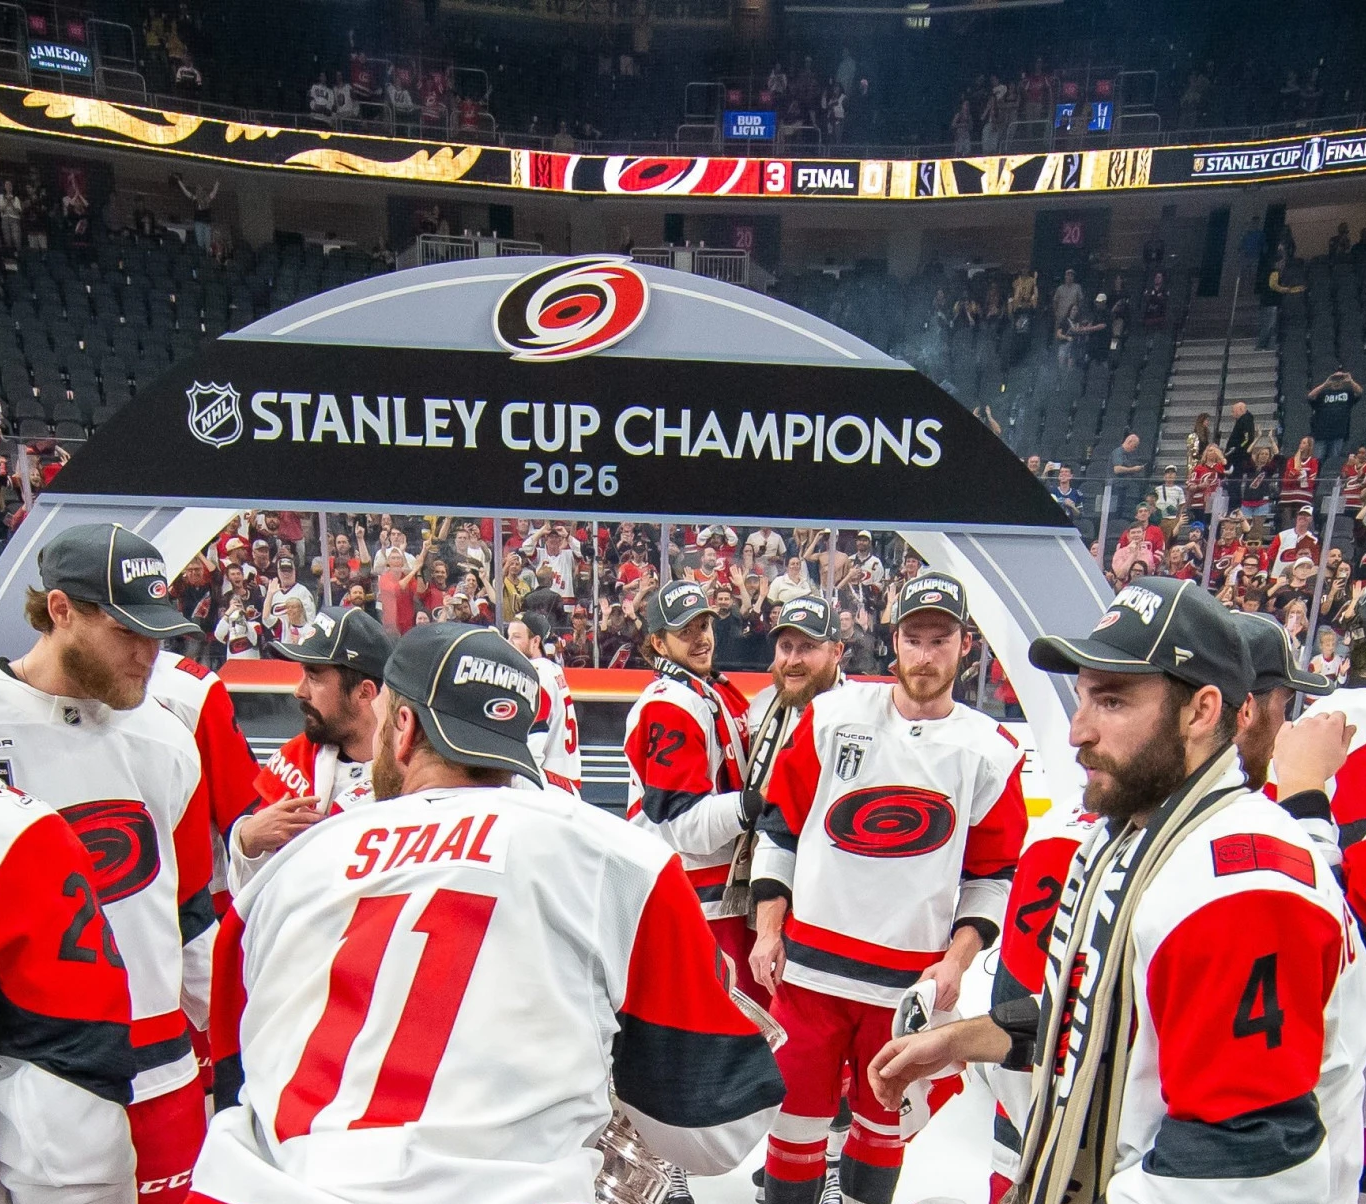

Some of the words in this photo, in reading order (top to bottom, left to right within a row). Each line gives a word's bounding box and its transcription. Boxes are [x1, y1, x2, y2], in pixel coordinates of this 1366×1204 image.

[30, 45, 88, 67] JAMESON
[732, 125, 766, 136] LIGHT
[737, 115, 762, 126] BUD
[1206, 154, 1270, 172] STANLEY
[1271, 149, 1301, 167] CUP
[765, 162, 784, 189] 3
[797, 168, 854, 189] FINAL
[862, 163, 881, 192] 0
[201, 402, 231, 432] NHL
[250, 390, 486, 449] STANLEY
[501, 402, 600, 453] CUP
[614, 406, 942, 467] CHAMPIONS
[523, 462, 620, 497] 2026
[905, 578, 959, 602] CHAMPIONS
[646, 721, 685, 767] 82
[345, 814, 497, 881] STAAL
[275, 888, 497, 1145] 11
[1232, 953, 1286, 1050] 4
[139, 1169, 195, 1194] CC
